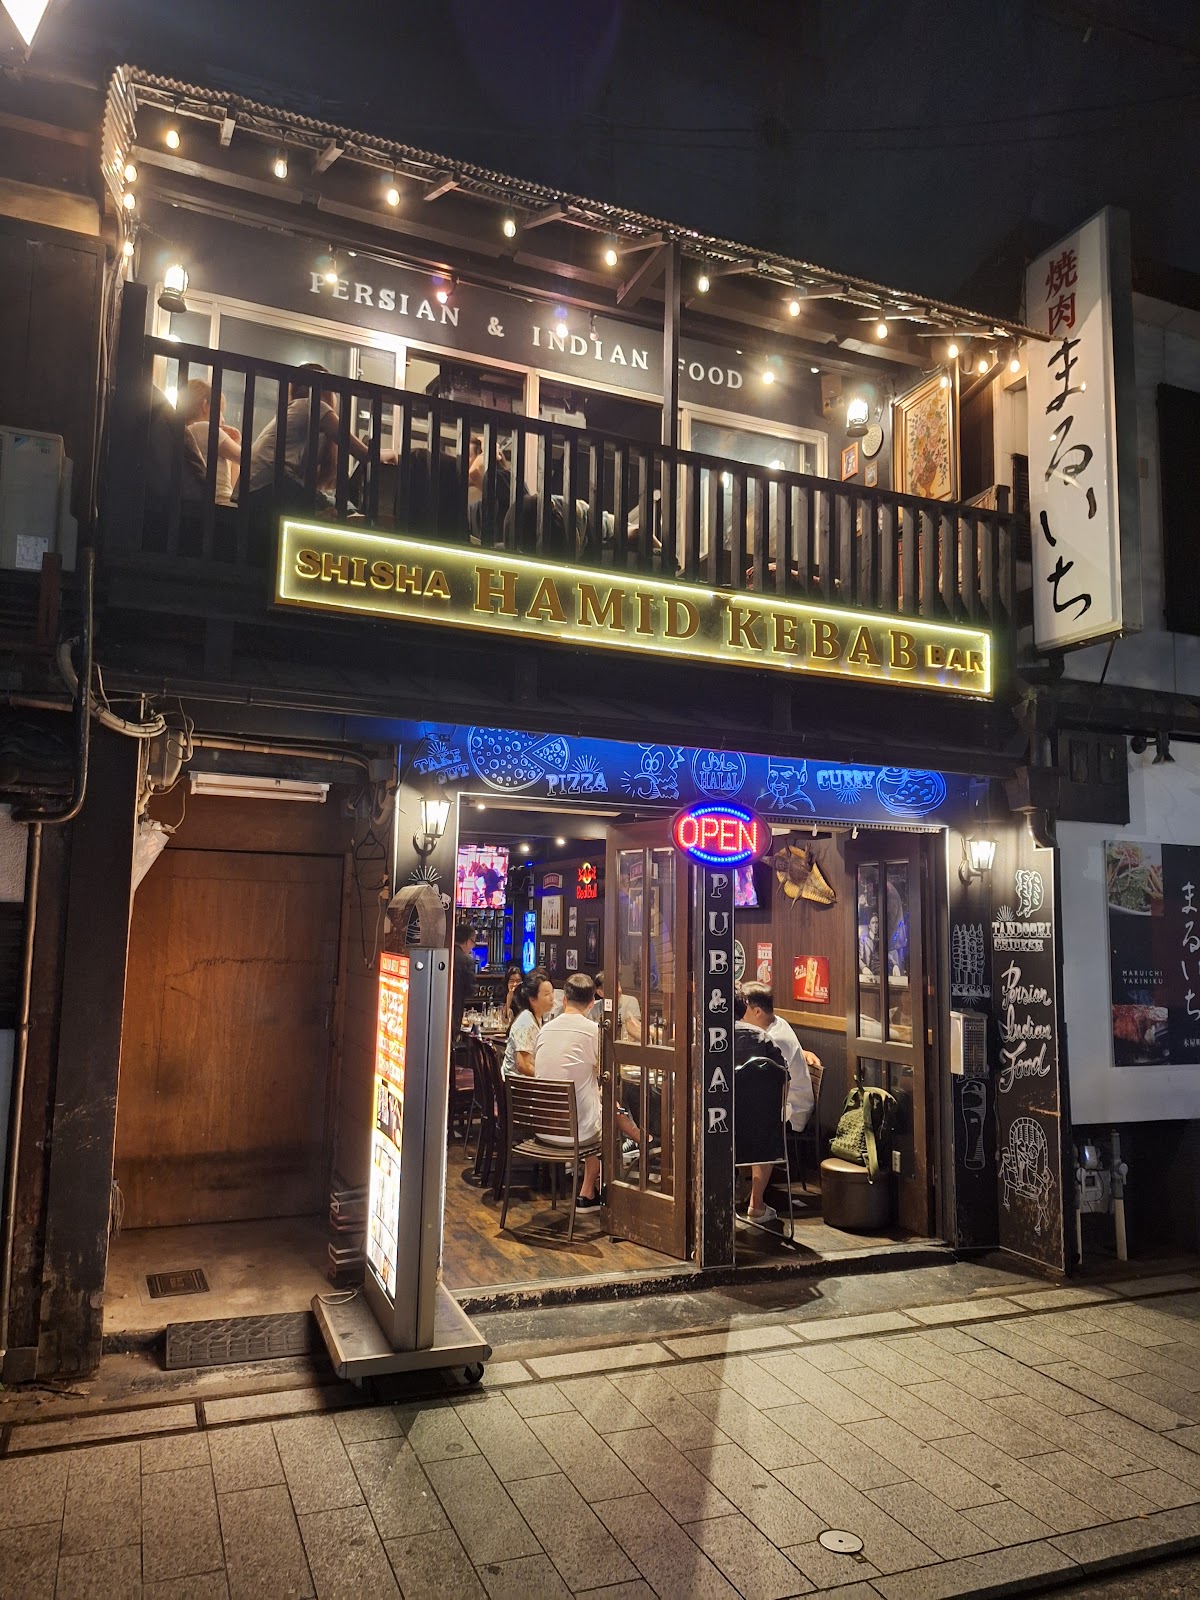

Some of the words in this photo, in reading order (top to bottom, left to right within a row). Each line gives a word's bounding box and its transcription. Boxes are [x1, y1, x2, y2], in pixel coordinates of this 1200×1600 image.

[1045, 249, 1078, 336] 焼肉
[309, 272, 459, 327] PERSIAN
[487, 316, 504, 338] &
[532, 326, 648, 370] INDIAN
[1040, 336, 1097, 621] まるいち
[295, 549, 451, 599] SHISHA
[473, 566, 700, 641] HAMID
[726, 605, 918, 671] KEBAB
[925, 644, 985, 674] BAR
[414, 749, 462, 775] TAKE
[436, 764, 470, 785] OUT
[546, 772, 608, 796] PIZZA
[700, 771, 740, 791] HALAL
[816, 769, 876, 791] CURRY
[678, 816, 758, 852] OPEN
[991, 921, 1052, 939] TANDOORI
[1001, 960, 1053, 1011] Persian
[1122, 970, 1164, 978] MARUICHI
[1123, 977, 1164, 985] YAKINIKU
[998, 1003, 1053, 1043] Indian
[999, 1040, 1051, 1094] Food
